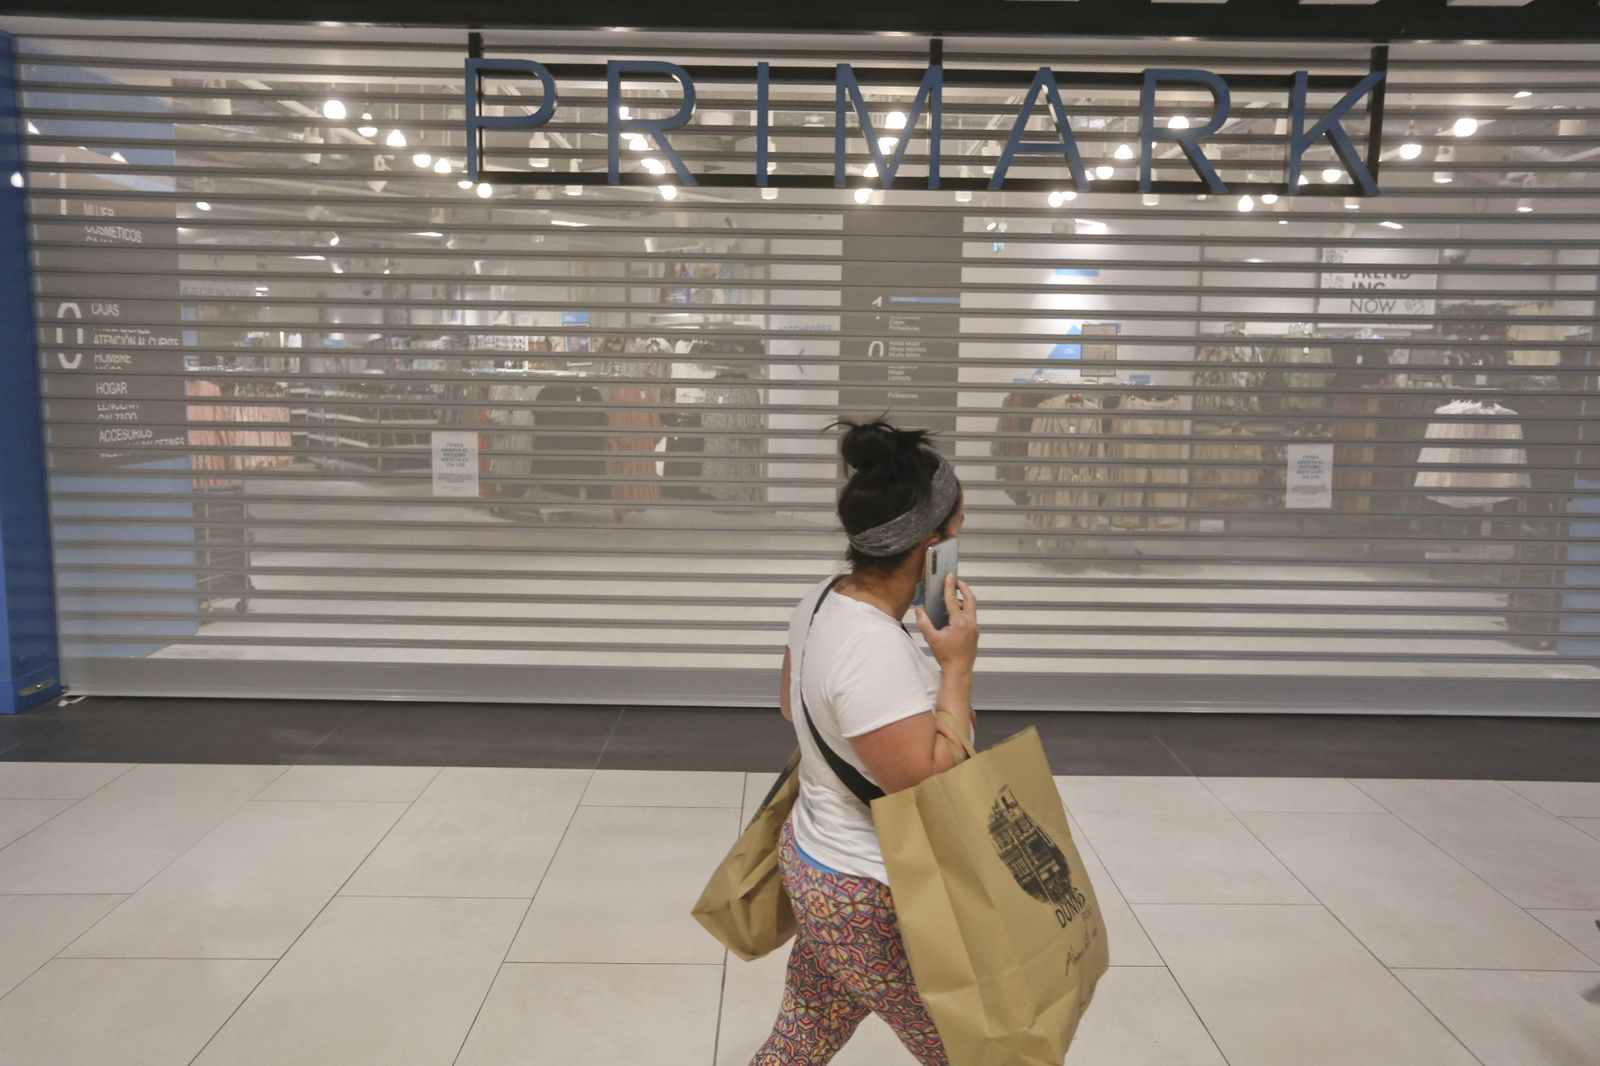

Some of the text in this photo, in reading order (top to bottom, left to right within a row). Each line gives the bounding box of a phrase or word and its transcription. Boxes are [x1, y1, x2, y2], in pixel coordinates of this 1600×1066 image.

[465, 58, 1388, 196] PRIMARK
[91, 303, 119, 317] CAJAS
[1350, 298, 1397, 314] NOW
[96, 382, 128, 395] HOGAR
